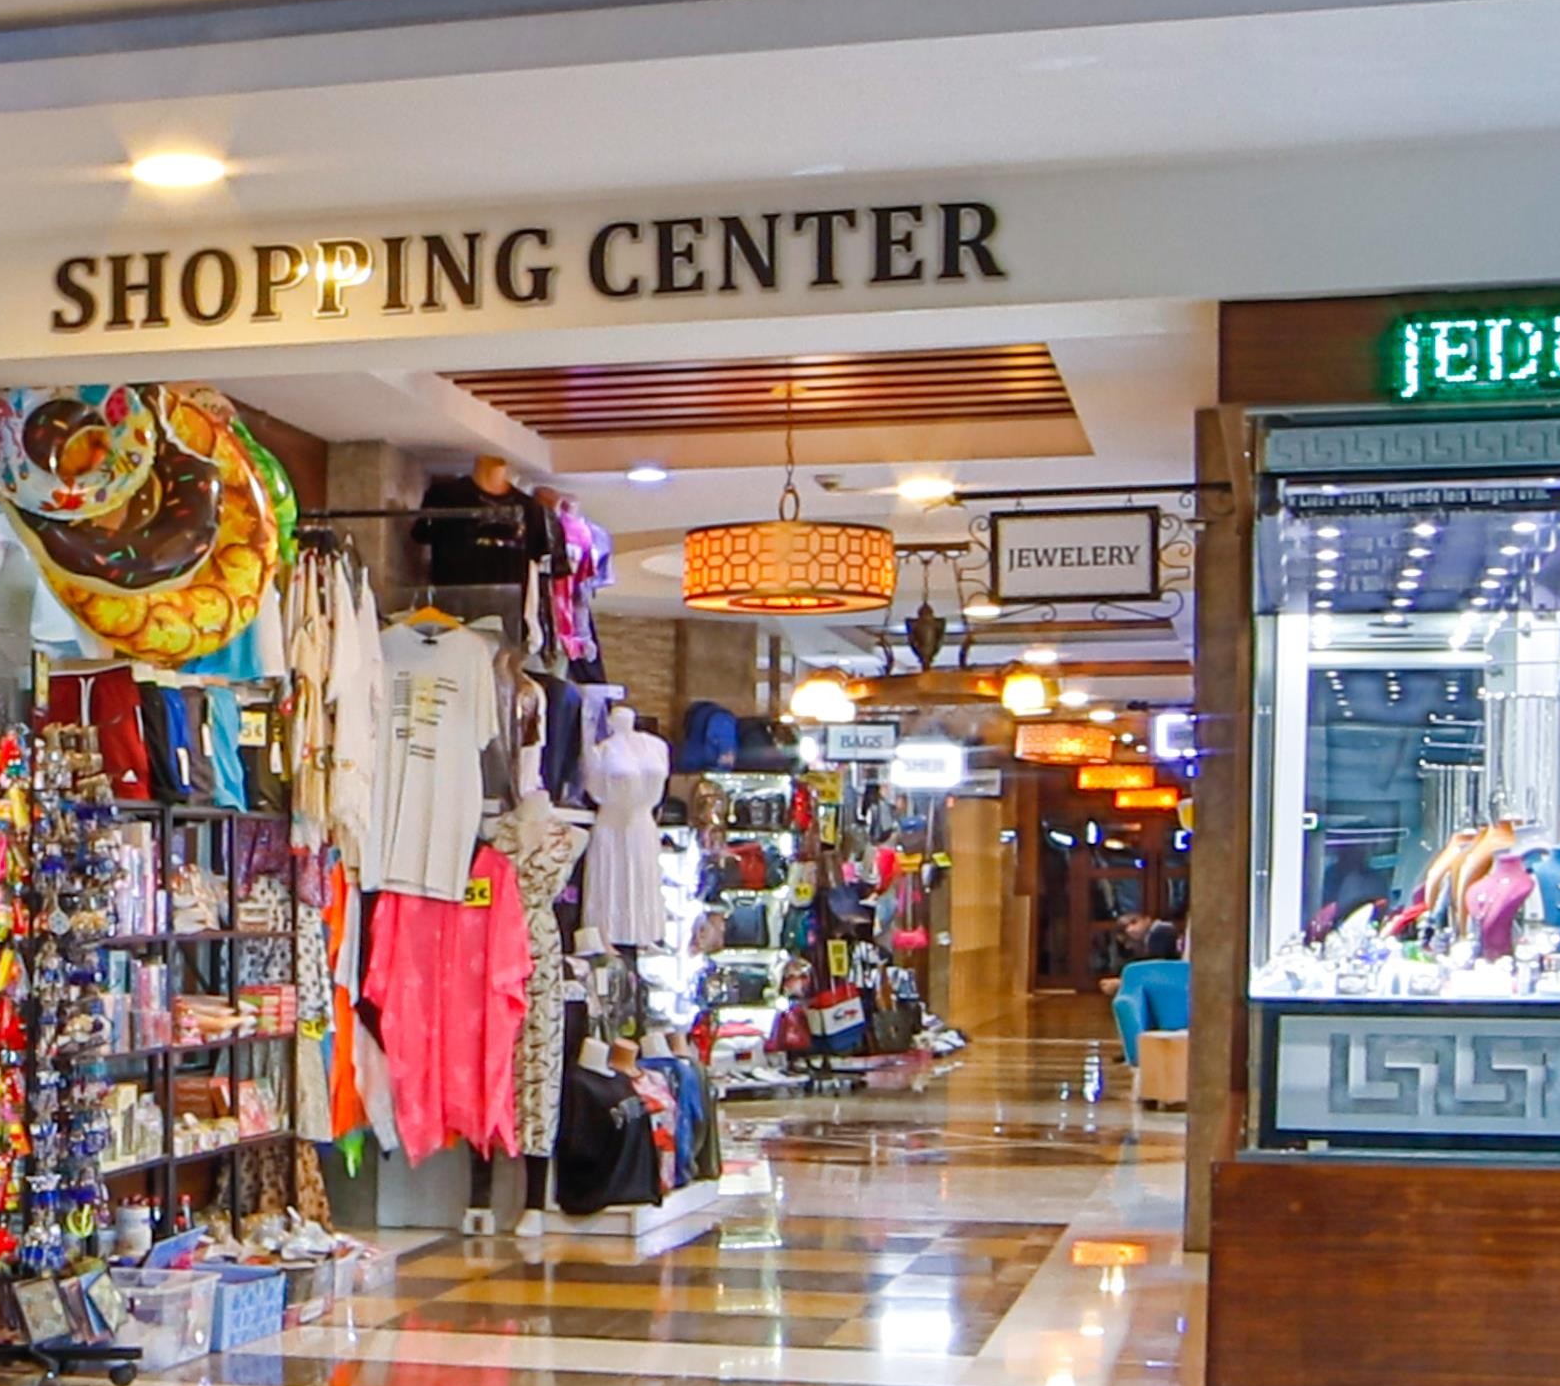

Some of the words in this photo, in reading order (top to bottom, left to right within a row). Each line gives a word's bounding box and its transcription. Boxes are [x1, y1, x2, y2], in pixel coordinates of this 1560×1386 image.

[50, 229, 554, 335] SHOPPING
[588, 200, 1006, 298] CENTER
[1008, 544, 1141, 573] JEWELERY
[840, 734, 883, 749] BAGS
